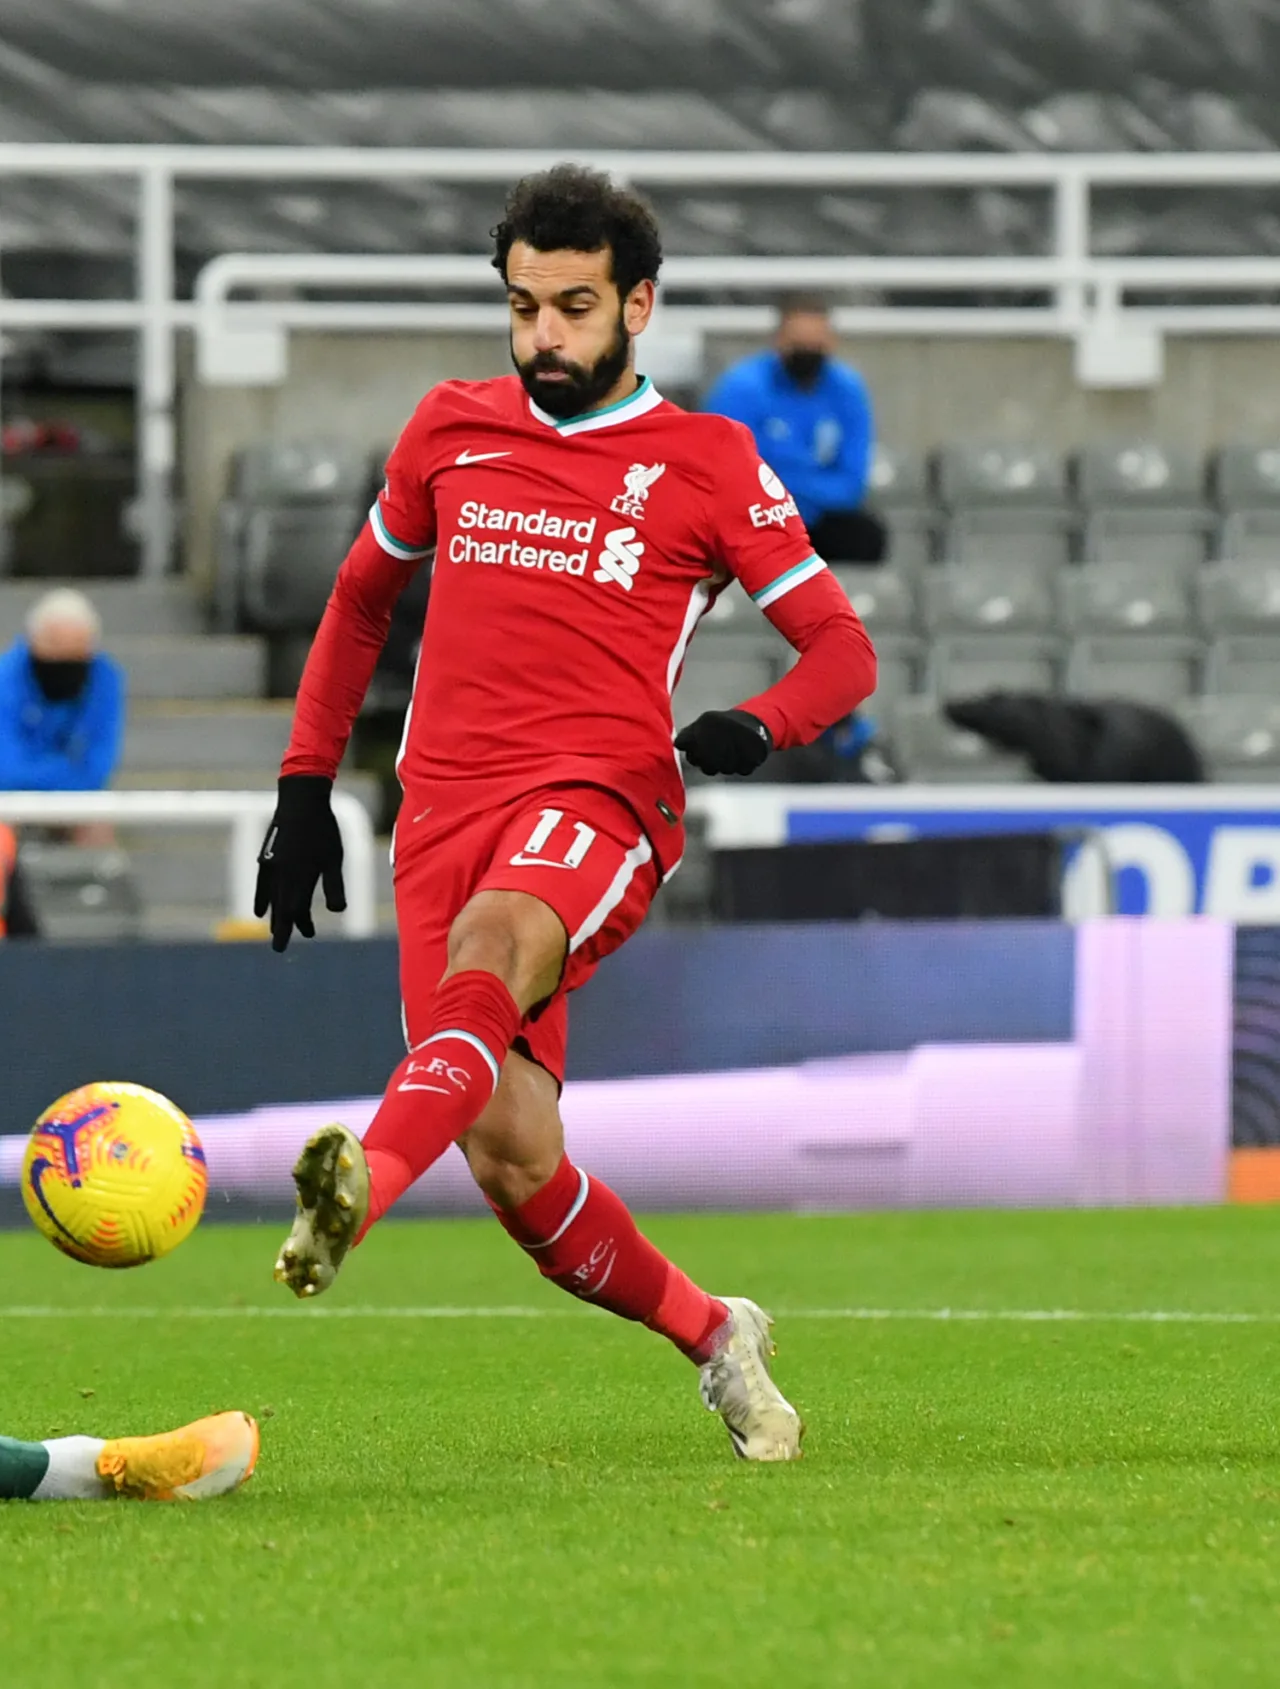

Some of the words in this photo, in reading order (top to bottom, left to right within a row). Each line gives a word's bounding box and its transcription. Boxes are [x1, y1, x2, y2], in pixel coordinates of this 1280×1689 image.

[457, 501, 596, 543] Standard
[448, 534, 588, 577] Chartered
[523, 808, 596, 869] 11
